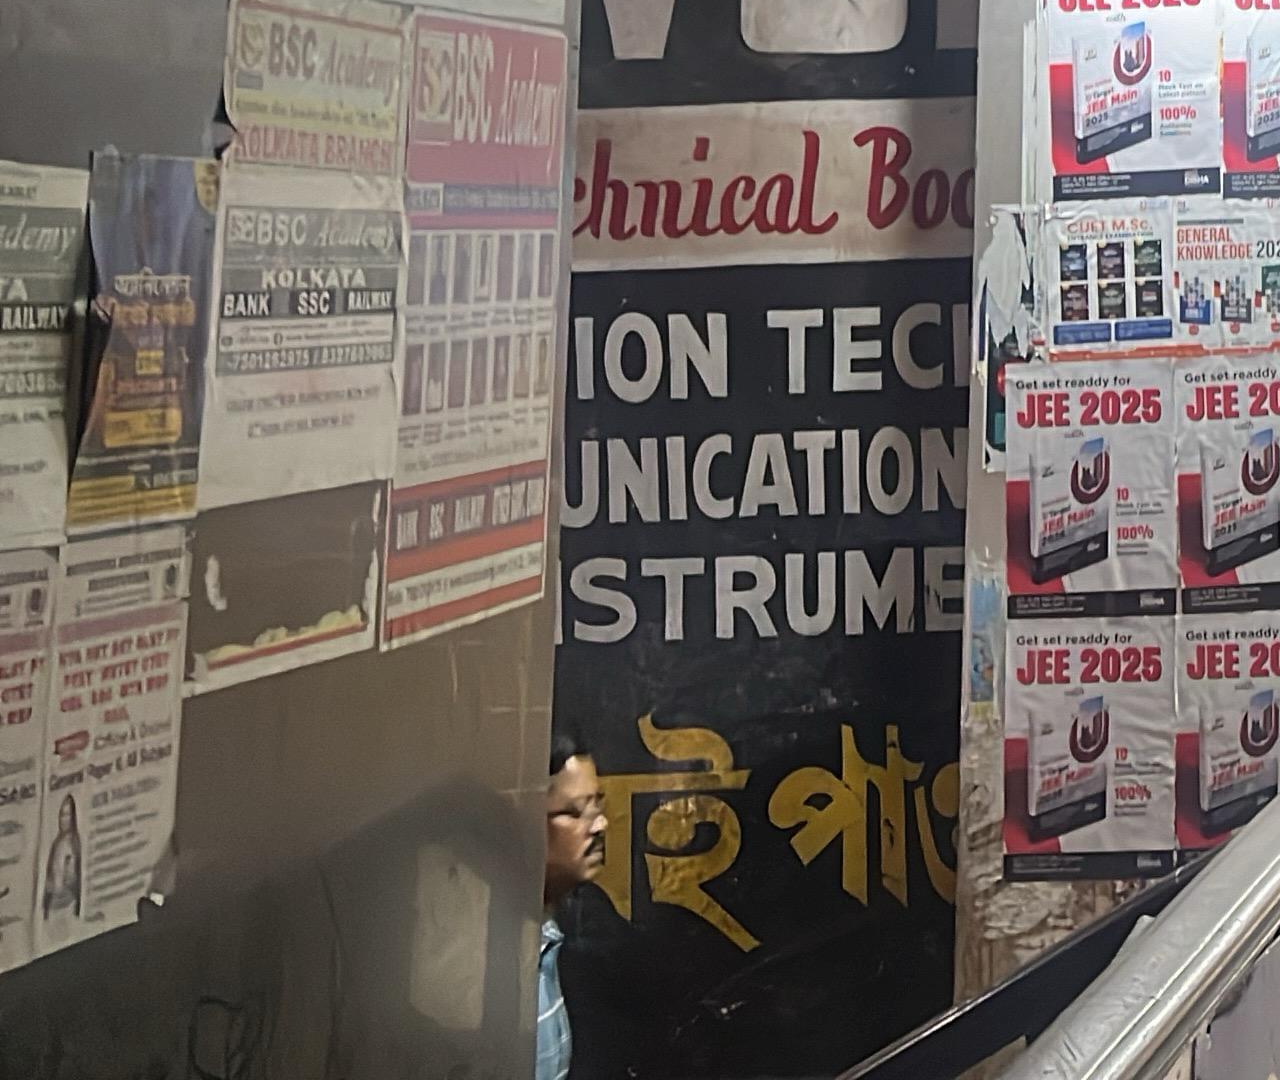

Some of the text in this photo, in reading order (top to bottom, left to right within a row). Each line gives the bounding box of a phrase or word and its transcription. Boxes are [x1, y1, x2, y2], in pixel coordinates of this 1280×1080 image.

[268, 21, 318, 80] BSC
[1159, 69, 1171, 82] 10
[1085, 89, 1138, 116] JEE Main
[1160, 105, 1196, 119] 100%
[1257, 98, 1280, 114] JEE
[256, 212, 307, 247] BSC
[1177, 226, 1233, 244] GENERAL
[1177, 243, 1253, 261] KNOWLEDGE
[261, 268, 367, 289] KOLKATA
[223, 291, 271, 316] BANK
[297, 290, 331, 315] SSC
[347, 290, 393, 311] RAILWAY
[2, 306, 67, 331] RAILWAY
[574, 303, 969, 401] ION TEC
[1016, 376, 1131, 390] Get set readdy for
[1185, 373, 1206, 384] Get
[1211, 372, 1228, 382] set
[1233, 369, 1277, 381] readdy
[1017, 389, 1162, 429] JEE 2025
[1186, 384, 1239, 421] JEE
[1117, 525, 1153, 540] 100%
[554, 546, 965, 646] STRUME
[1017, 633, 1132, 646] Get set readdy for
[1186, 630, 1207, 641] Get
[1213, 630, 1230, 640] set
[1235, 628, 1279, 640] readdy
[1017, 646, 1162, 685] JEE 2025
[1187, 642, 1240, 680] JEE
